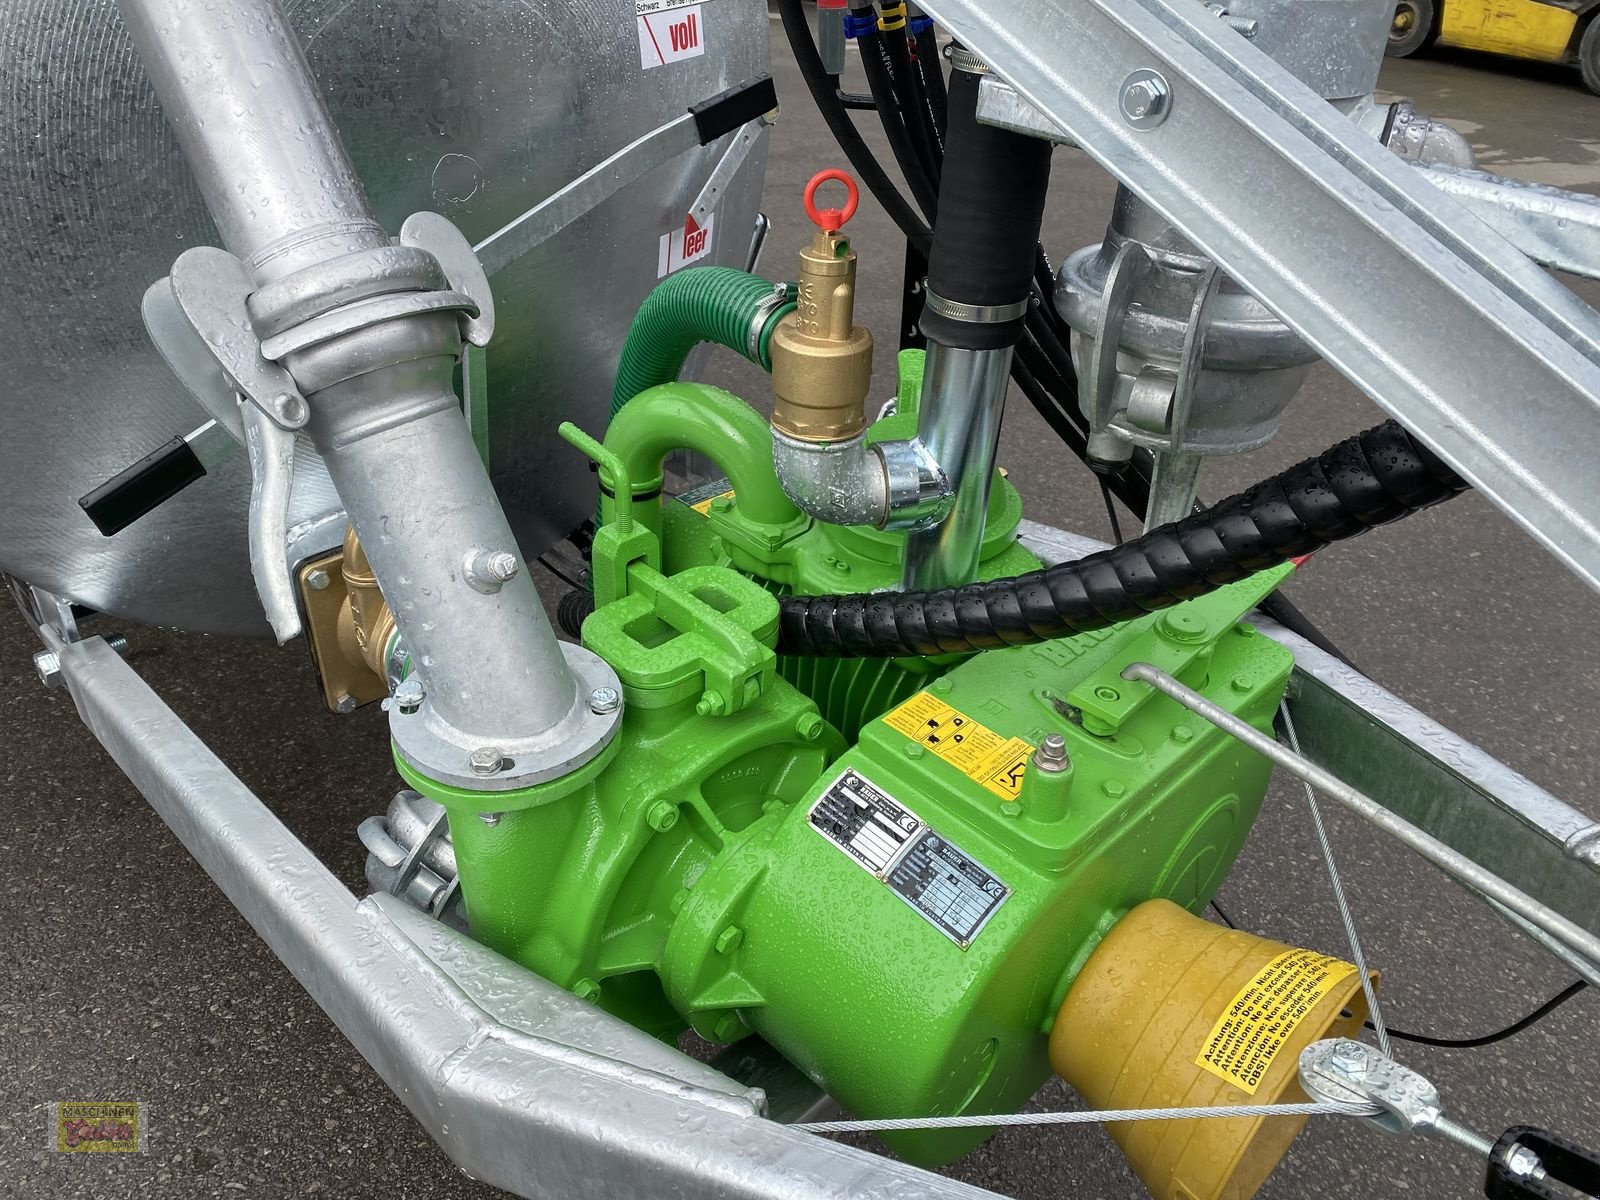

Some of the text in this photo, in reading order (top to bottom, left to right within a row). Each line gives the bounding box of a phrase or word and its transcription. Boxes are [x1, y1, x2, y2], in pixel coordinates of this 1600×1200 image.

[636, 2, 660, 13] Schwarz
[669, 13, 698, 52] voll
[682, 228, 708, 260] leer
[860, 787, 878, 801] BAUER
[843, 843, 864, 860] AUSTRIA
[941, 848, 962, 864] BAUER
[1205, 1019, 1232, 1061] Achtung:
[1230, 987, 1259, 1018] 540/min.
[1257, 968, 1275, 986] Nicht
[1212, 1018, 1245, 1067] Attention:
[1243, 1006, 1254, 1017] Do
[1253, 993, 1265, 1005] not
[1265, 968, 1287, 992] exceed
[1286, 960, 1298, 970] 540
[1221, 1023, 1253, 1071] Attention:
[1252, 1010, 1263, 1022] Ne
[1262, 997, 1275, 1011] pas
[1300, 961, 1310, 970] 540
[1231, 1023, 1268, 1077] Attenzione:
[1265, 1005, 1280, 1022] Non
[1279, 977, 1307, 1005] superare
[1308, 965, 1320, 975] 540
[1240, 1034, 1272, 1082] Atención:
[1269, 1021, 1281, 1034] No
[1280, 992, 1305, 1021] esceder
[1303, 971, 1329, 993] 540/min.
[1248, 1060, 1267, 1086] OBS!
[1264, 1039, 1281, 1059] Ikke
[1281, 1020, 1295, 1037] over
